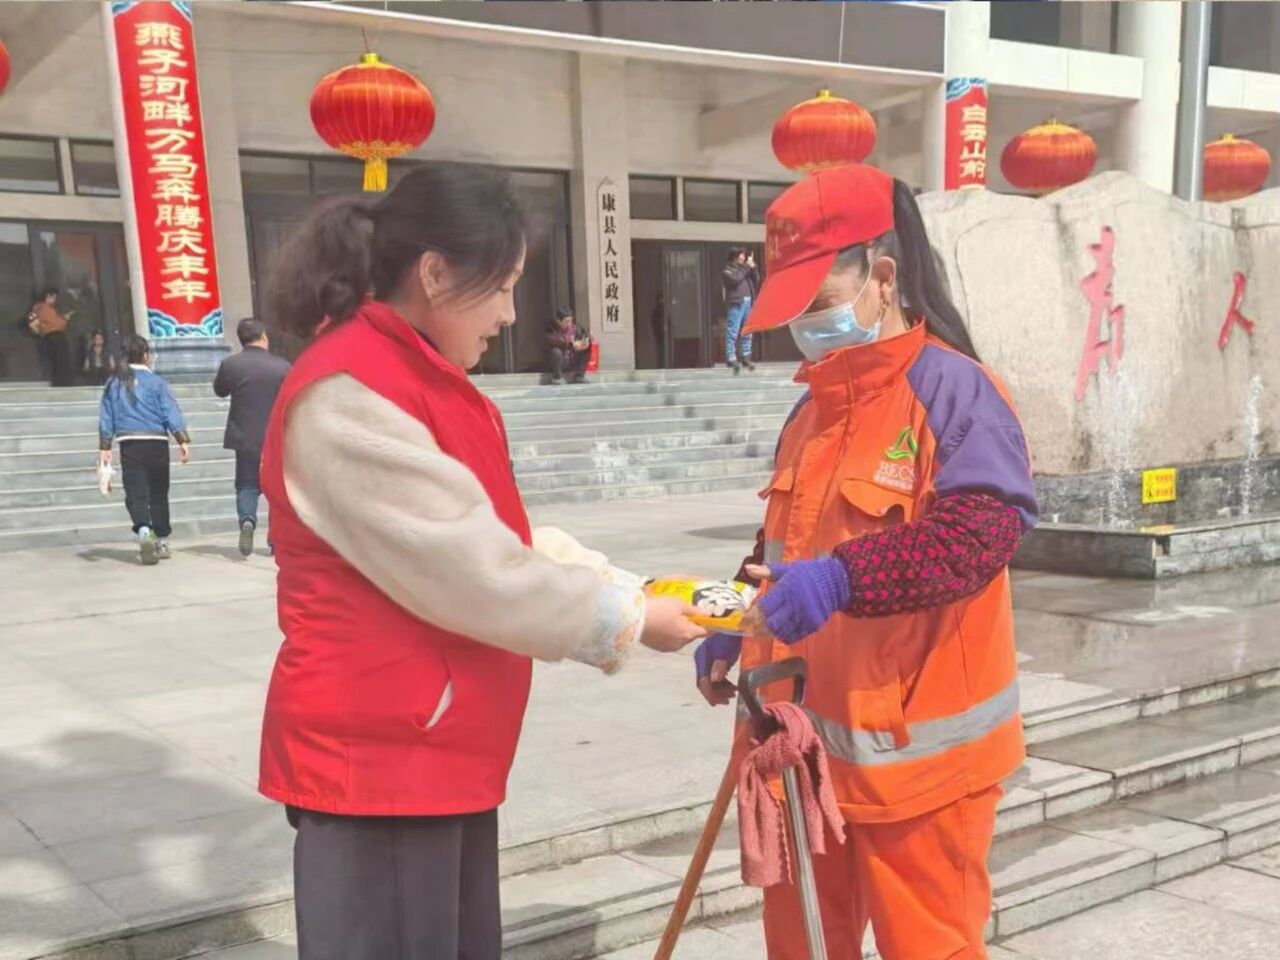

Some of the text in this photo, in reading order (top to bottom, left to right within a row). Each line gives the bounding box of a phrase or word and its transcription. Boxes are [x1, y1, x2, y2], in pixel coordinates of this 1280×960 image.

[134, 21, 212, 305] 燕子河畔万马奔腾庆丰年
[959, 104, 987, 191] 白云山前
[602, 192, 620, 324] 康县人民政府
